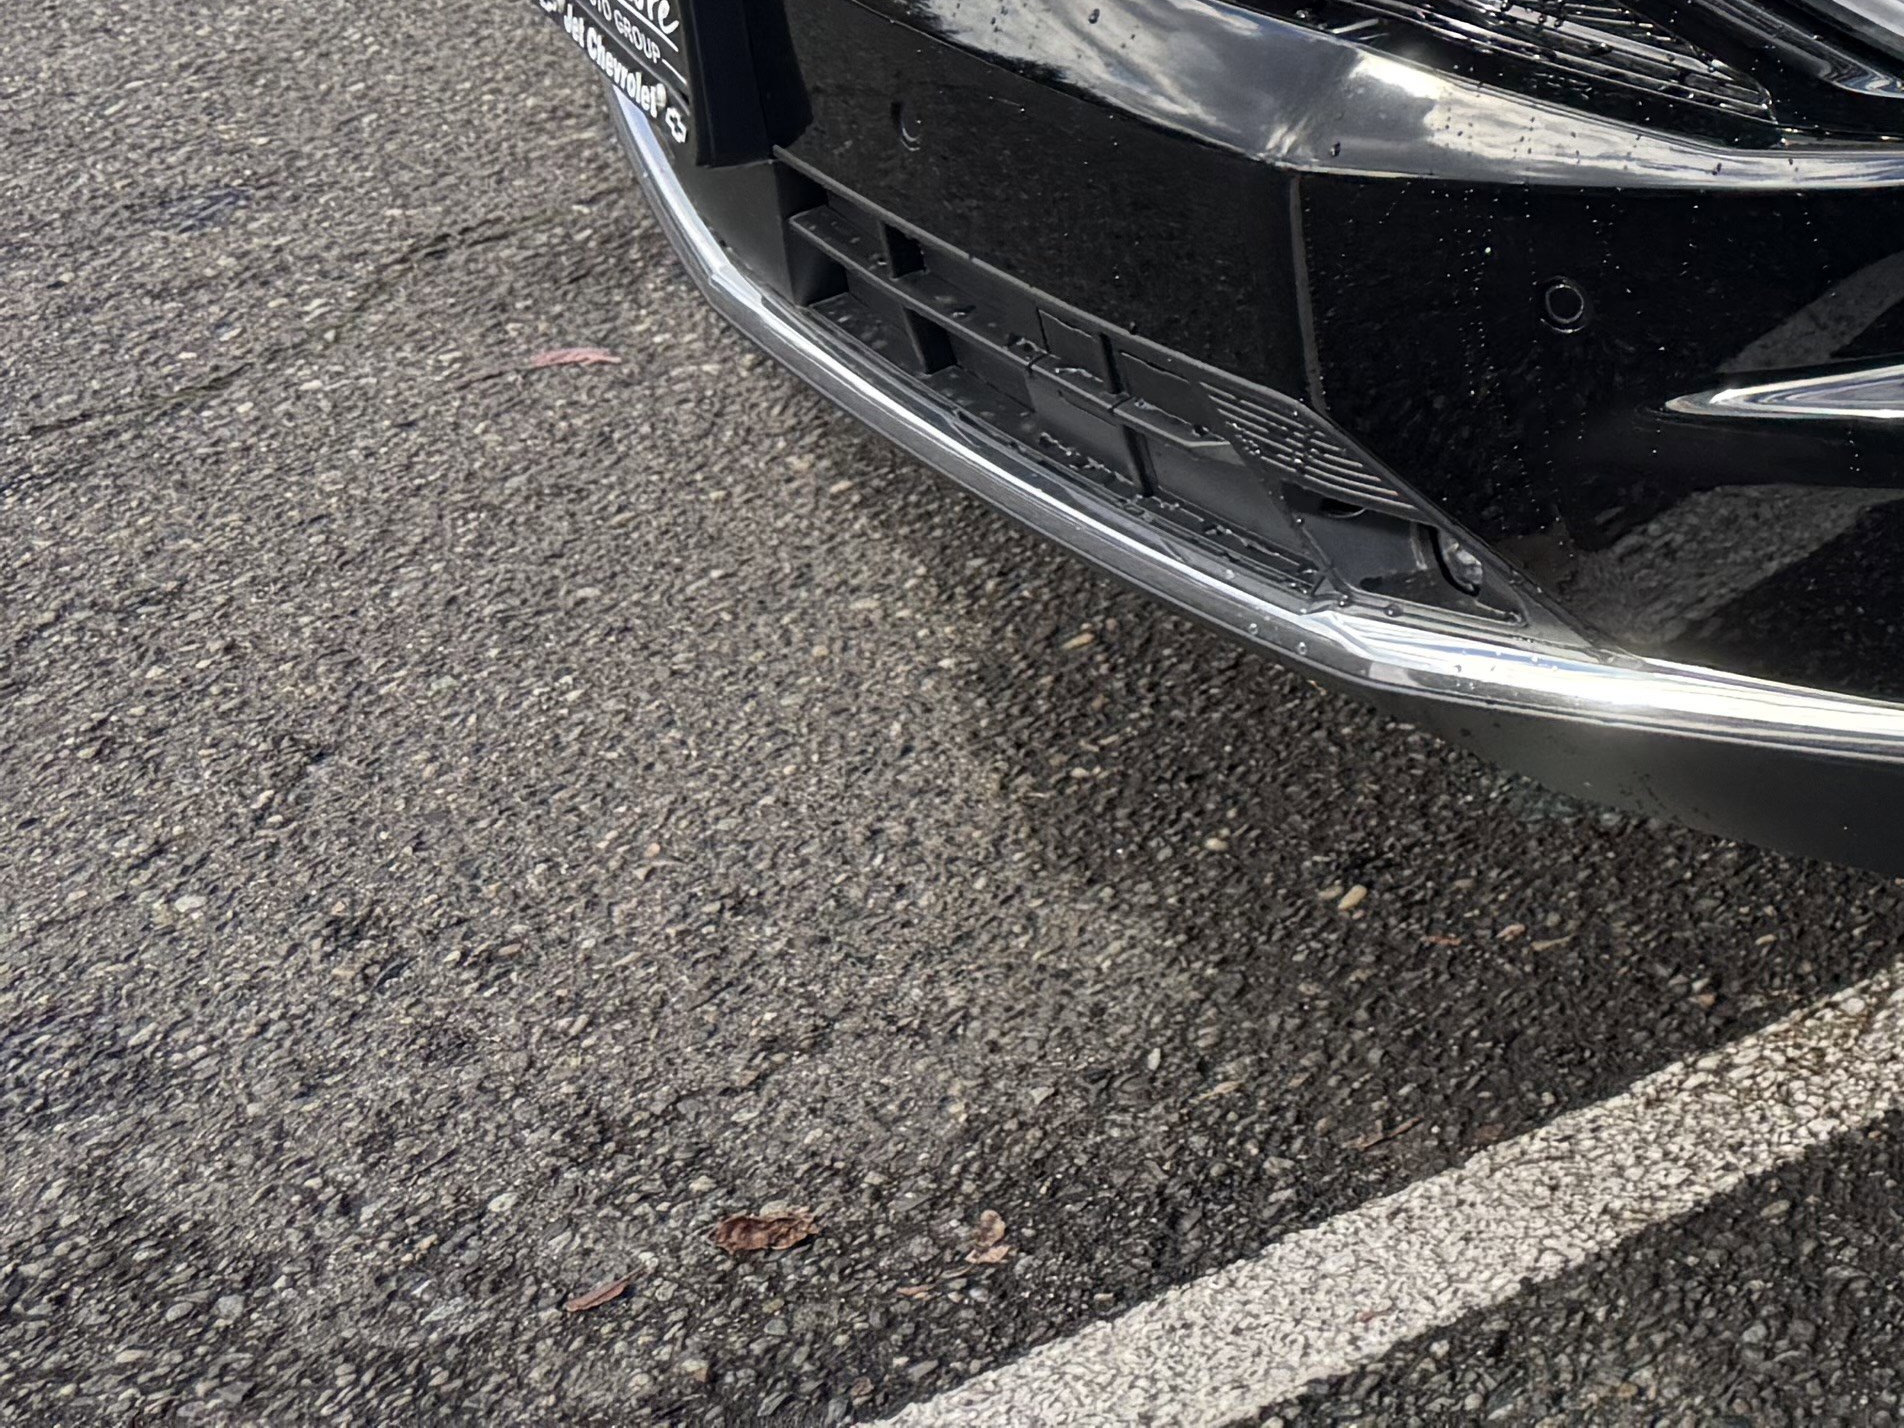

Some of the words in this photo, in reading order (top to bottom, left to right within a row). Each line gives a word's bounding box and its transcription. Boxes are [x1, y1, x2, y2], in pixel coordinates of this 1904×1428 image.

[563, 3, 585, 48] Jet
[587, 27, 659, 118] Chevrolet
[614, 12, 662, 65] GROUP
